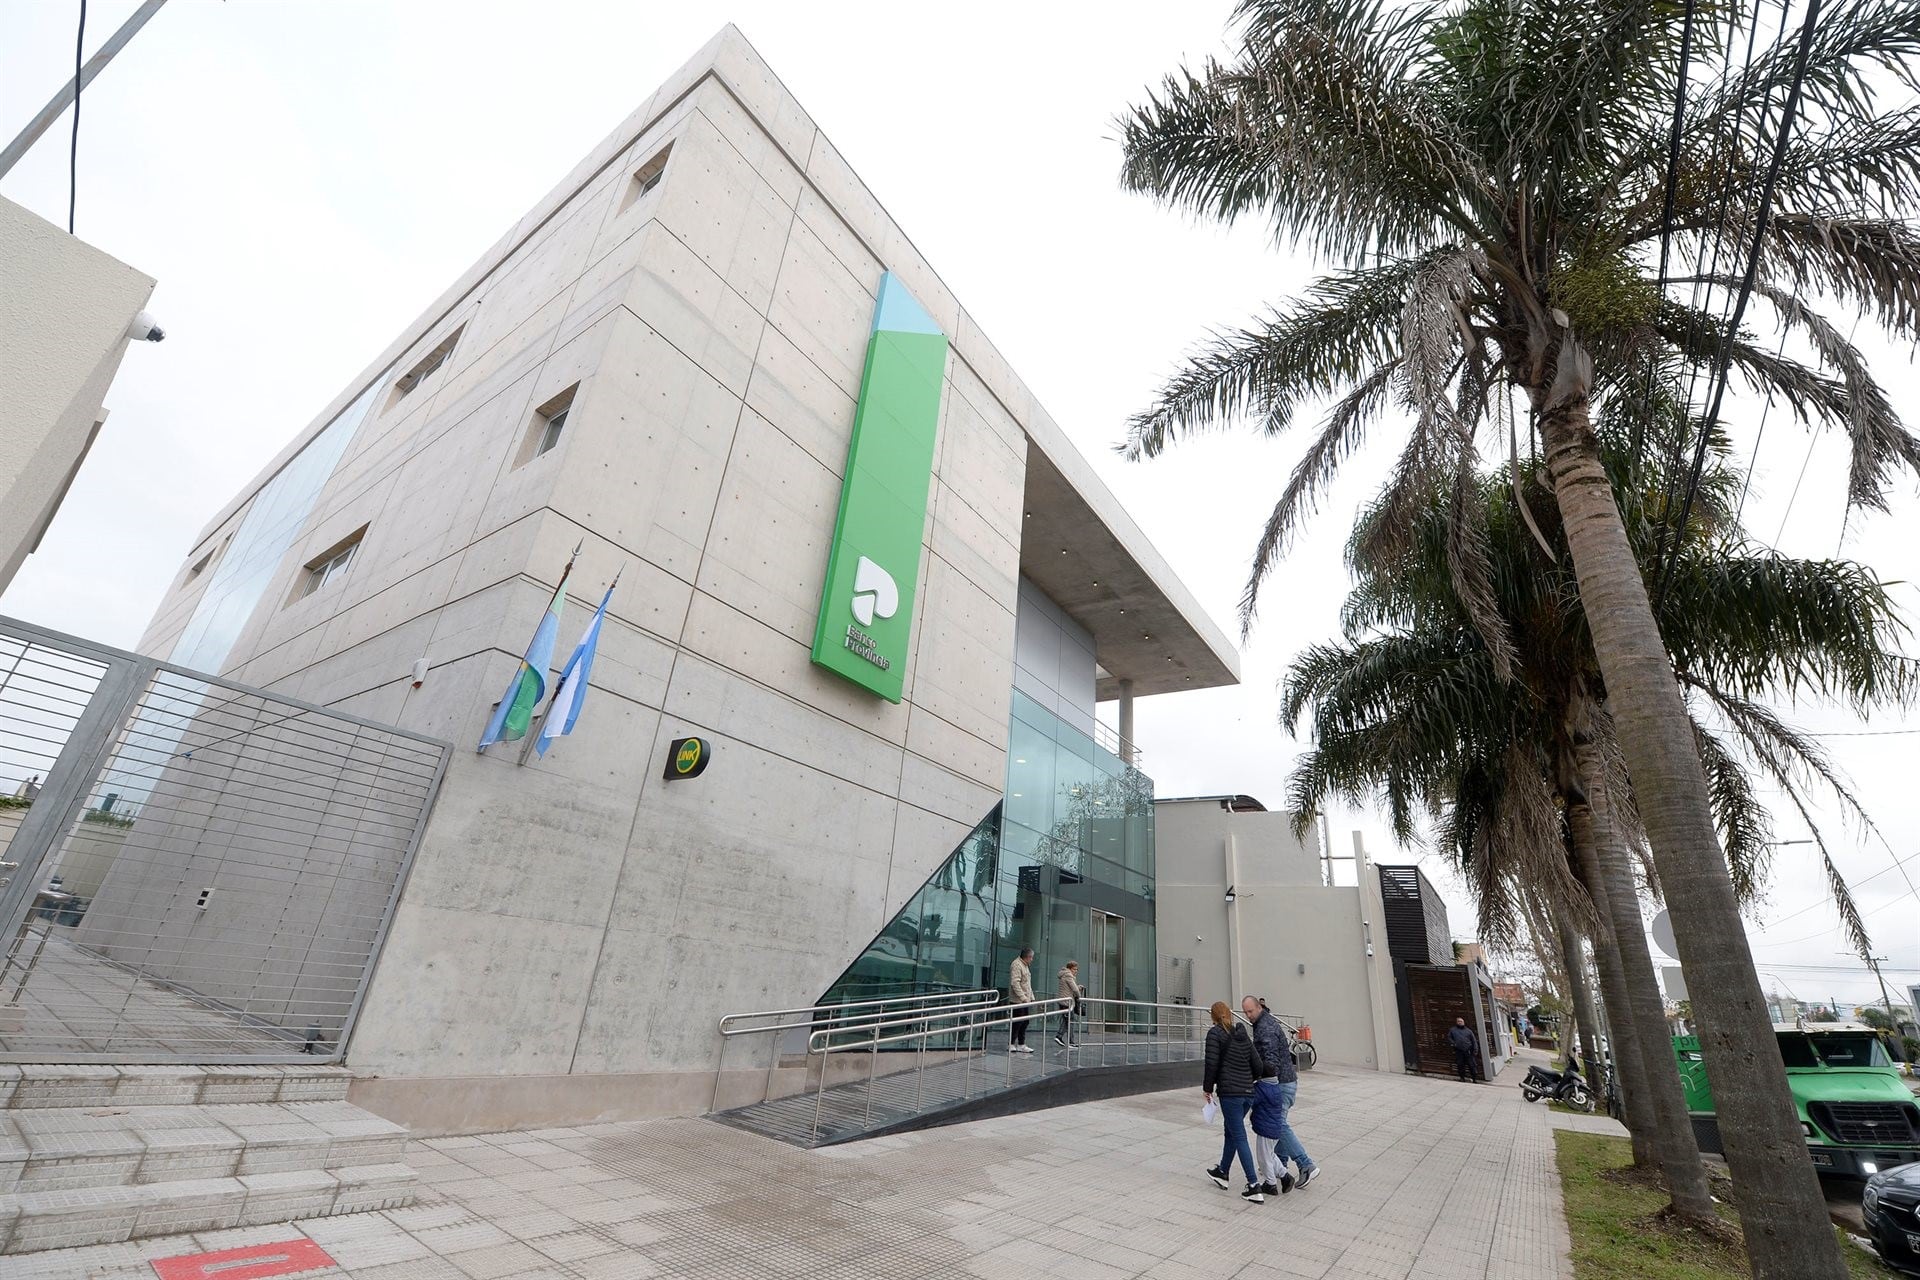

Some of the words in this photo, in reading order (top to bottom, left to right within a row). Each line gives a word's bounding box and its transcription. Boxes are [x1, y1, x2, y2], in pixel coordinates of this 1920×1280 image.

[847, 624, 877, 648] Banco
[845, 636, 889, 670] Provincia
[678, 749, 697, 761] LINK
